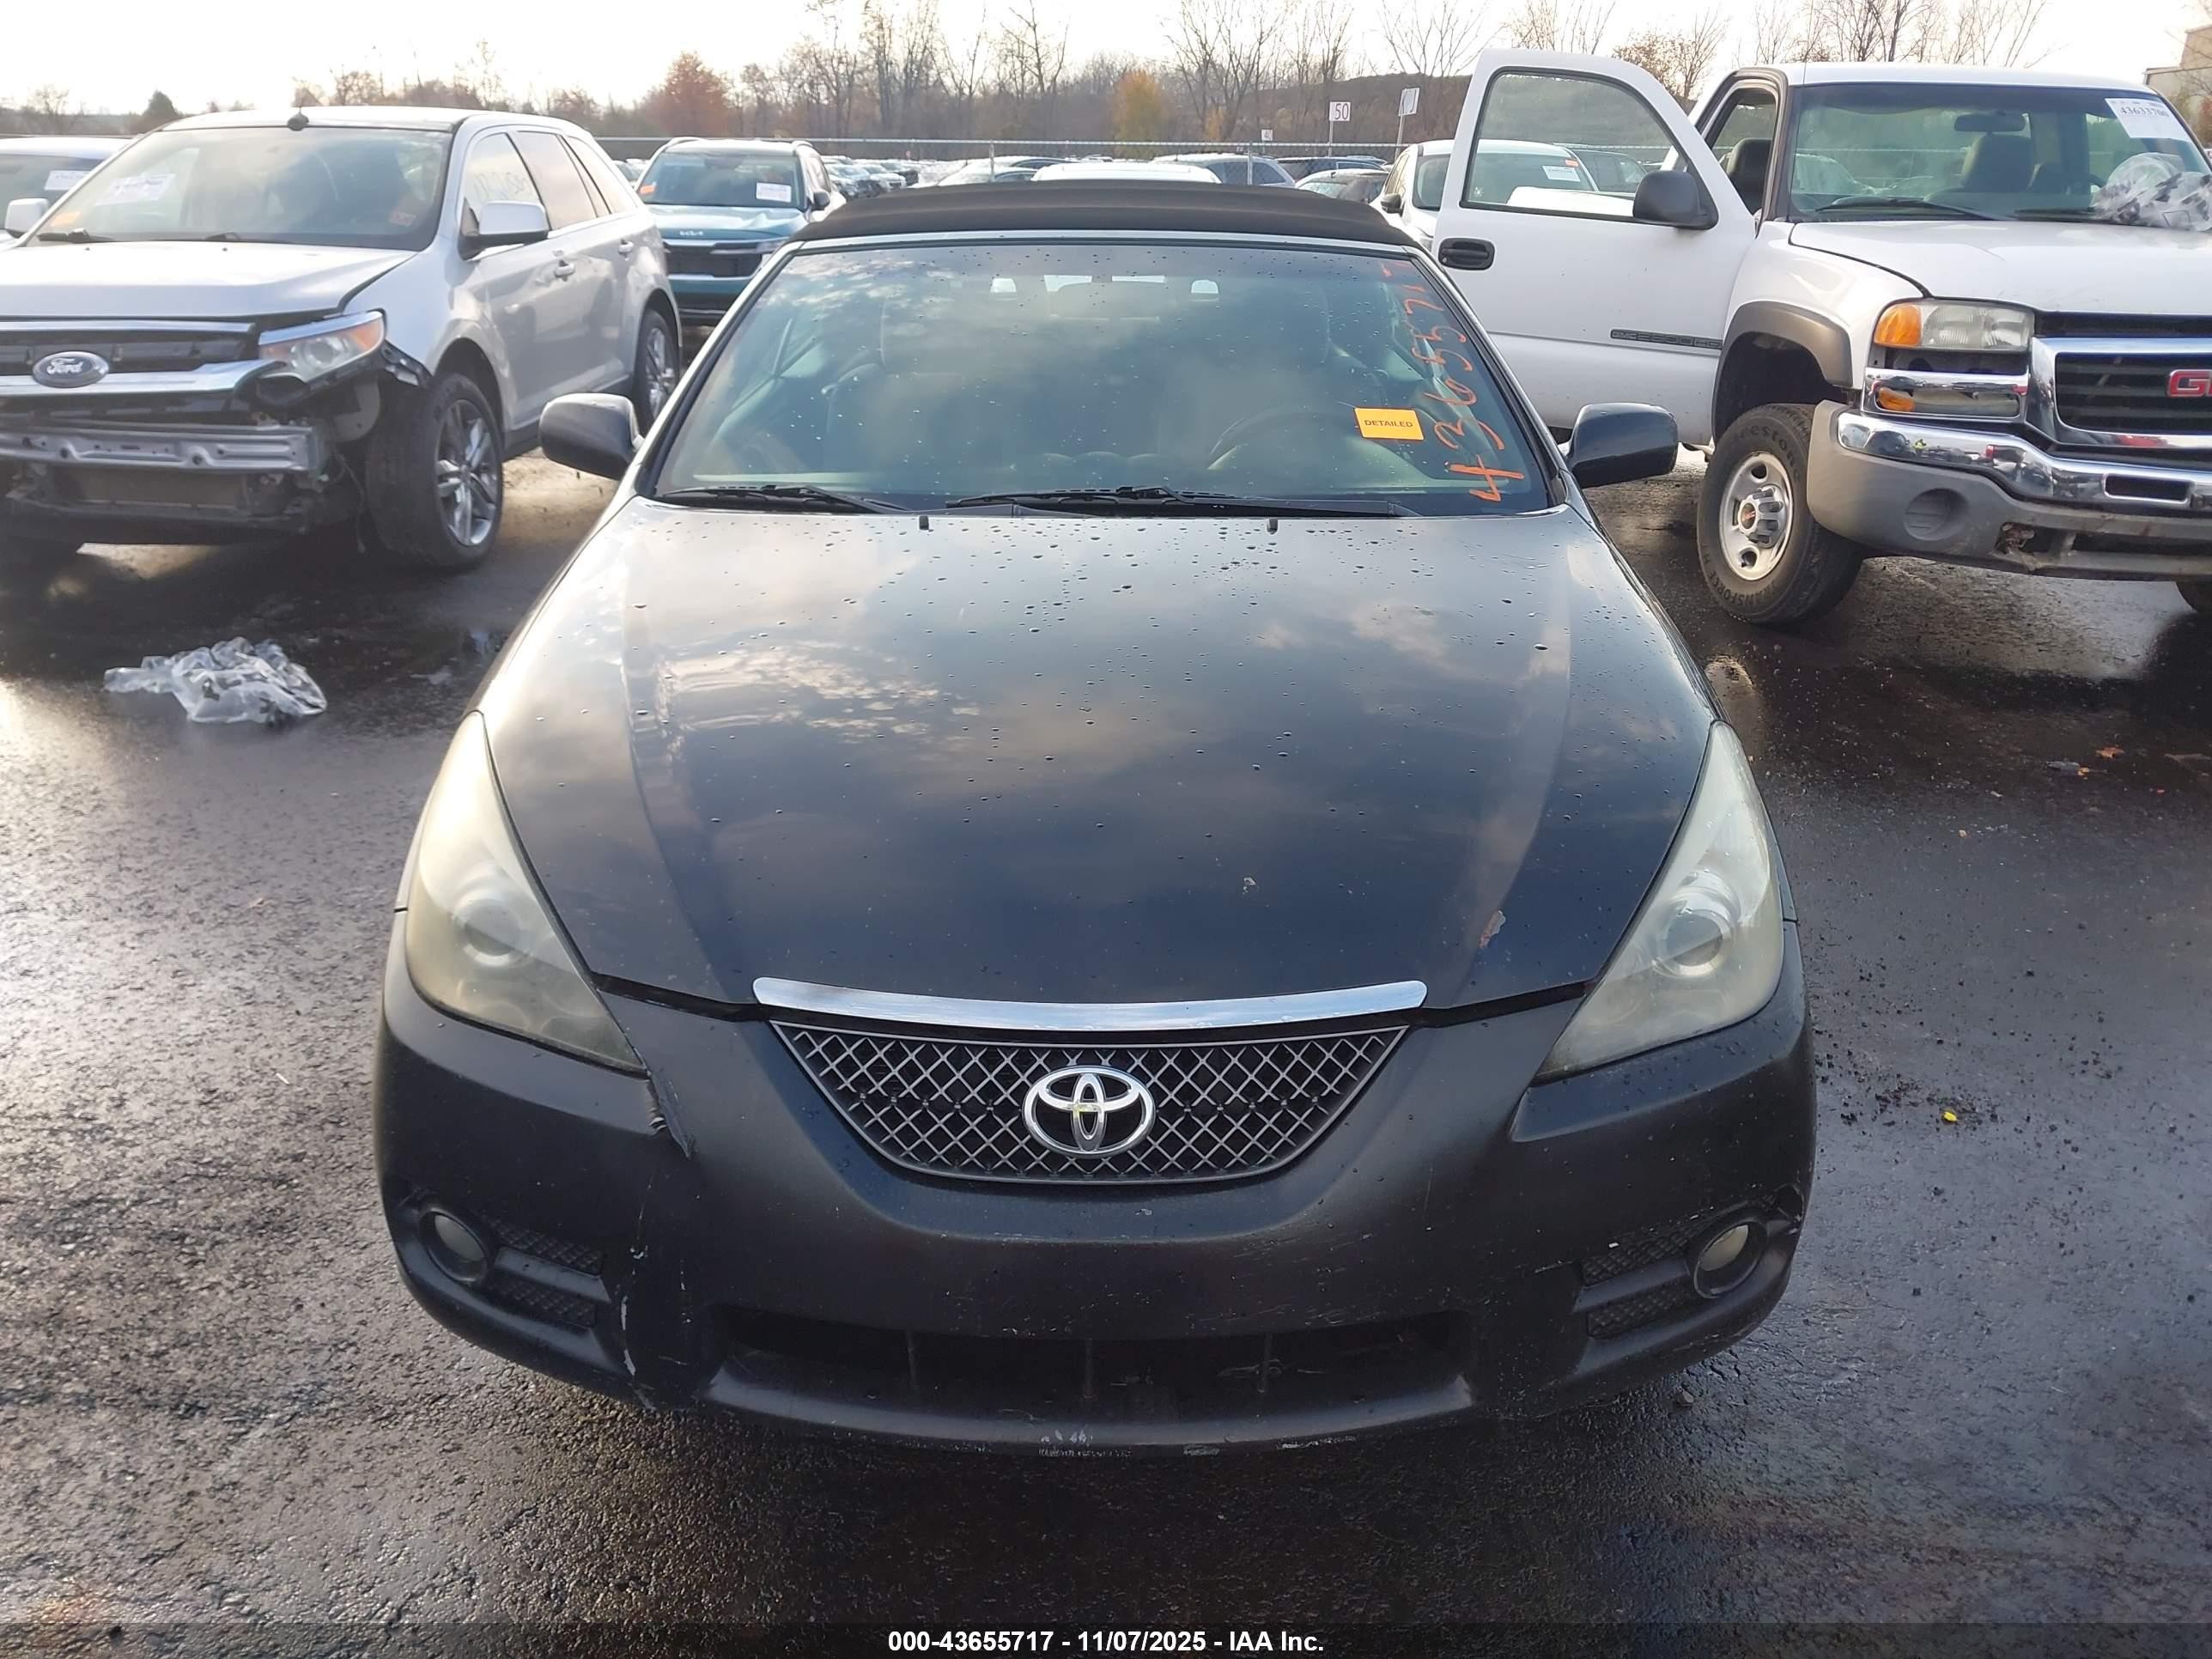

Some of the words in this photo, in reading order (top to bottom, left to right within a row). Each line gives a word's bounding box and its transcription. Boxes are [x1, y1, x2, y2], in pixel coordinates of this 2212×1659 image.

[1335, 103, 1349, 120] 50
[46, 357, 84, 375] Ford
[2166, 369, 2212, 398] G
[1364, 419, 1413, 428] DETAILED
